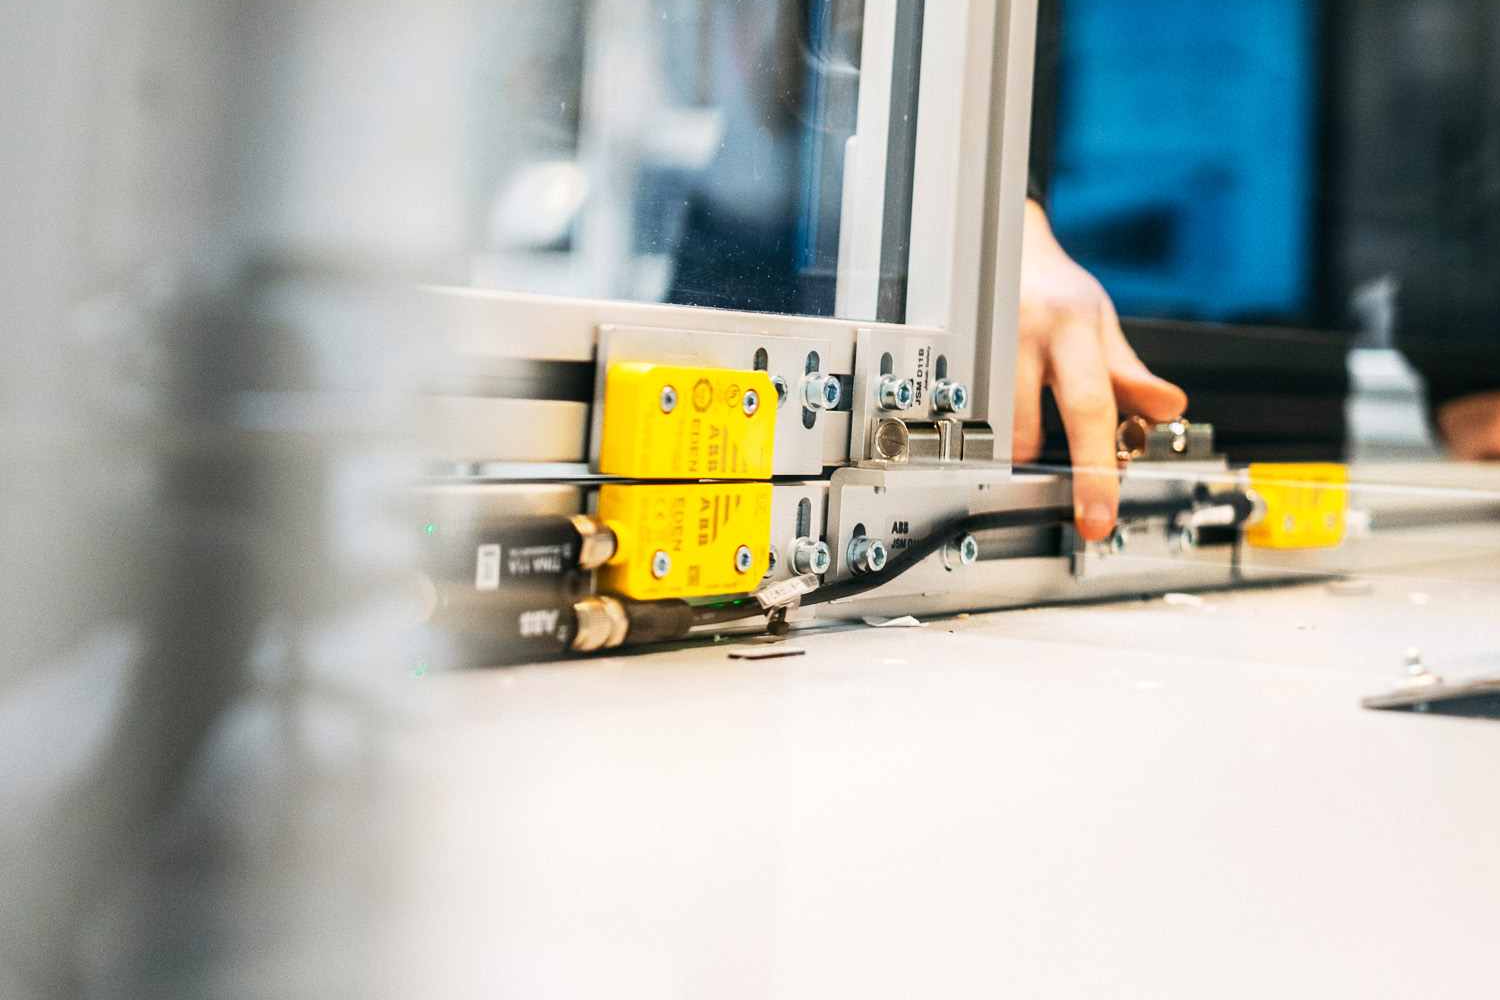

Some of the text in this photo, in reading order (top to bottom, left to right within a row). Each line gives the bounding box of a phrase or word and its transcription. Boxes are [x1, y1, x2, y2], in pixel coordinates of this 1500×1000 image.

[916, 348, 925, 378] D11B
[688, 418, 700, 472] EDEN
[673, 497, 685, 551] EDEN
[698, 497, 711, 547] ABB
[891, 521, 909, 534] ABB
[890, 538, 905, 548] JSM
